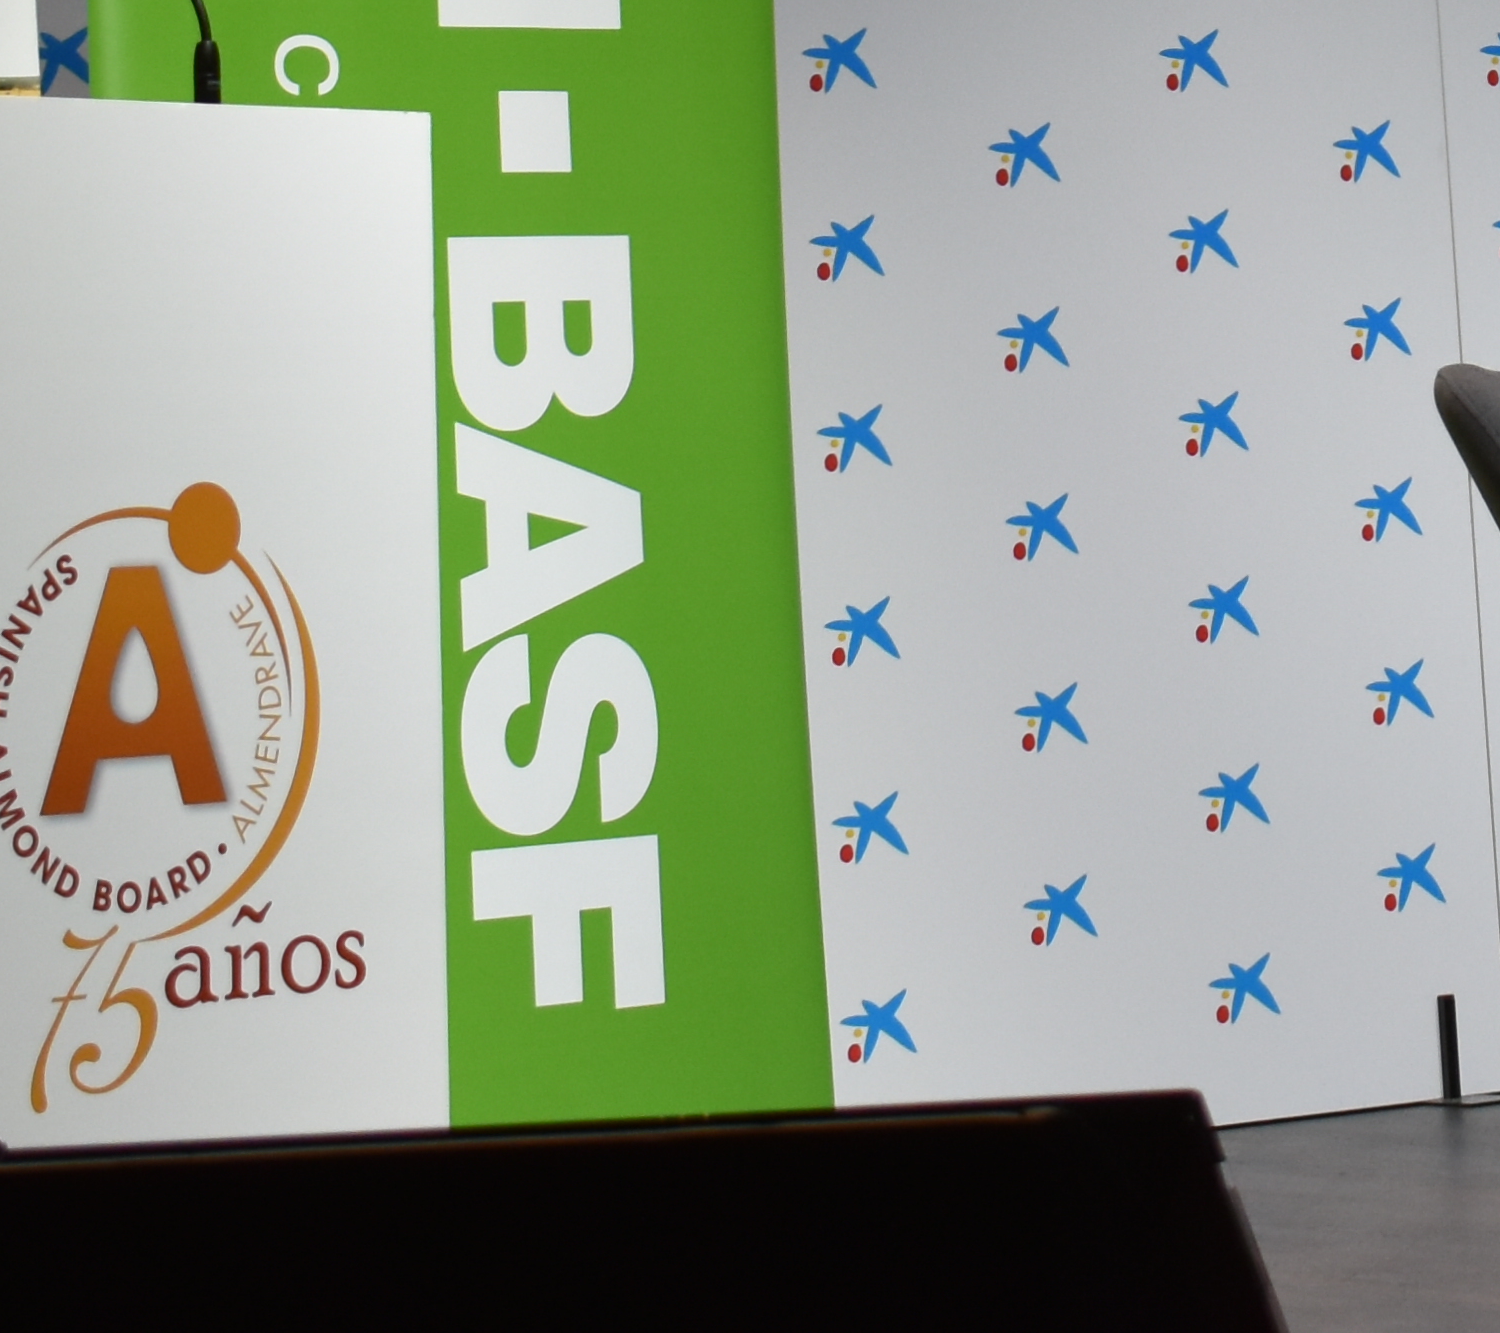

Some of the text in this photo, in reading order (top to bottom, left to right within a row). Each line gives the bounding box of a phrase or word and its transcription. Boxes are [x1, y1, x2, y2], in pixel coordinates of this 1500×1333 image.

[229, 595, 282, 843] ALMENDRAVE
[446, 235, 666, 1011] BASF
[92, 850, 212, 914] BOARD
[29, 901, 368, 1114] 75 años
